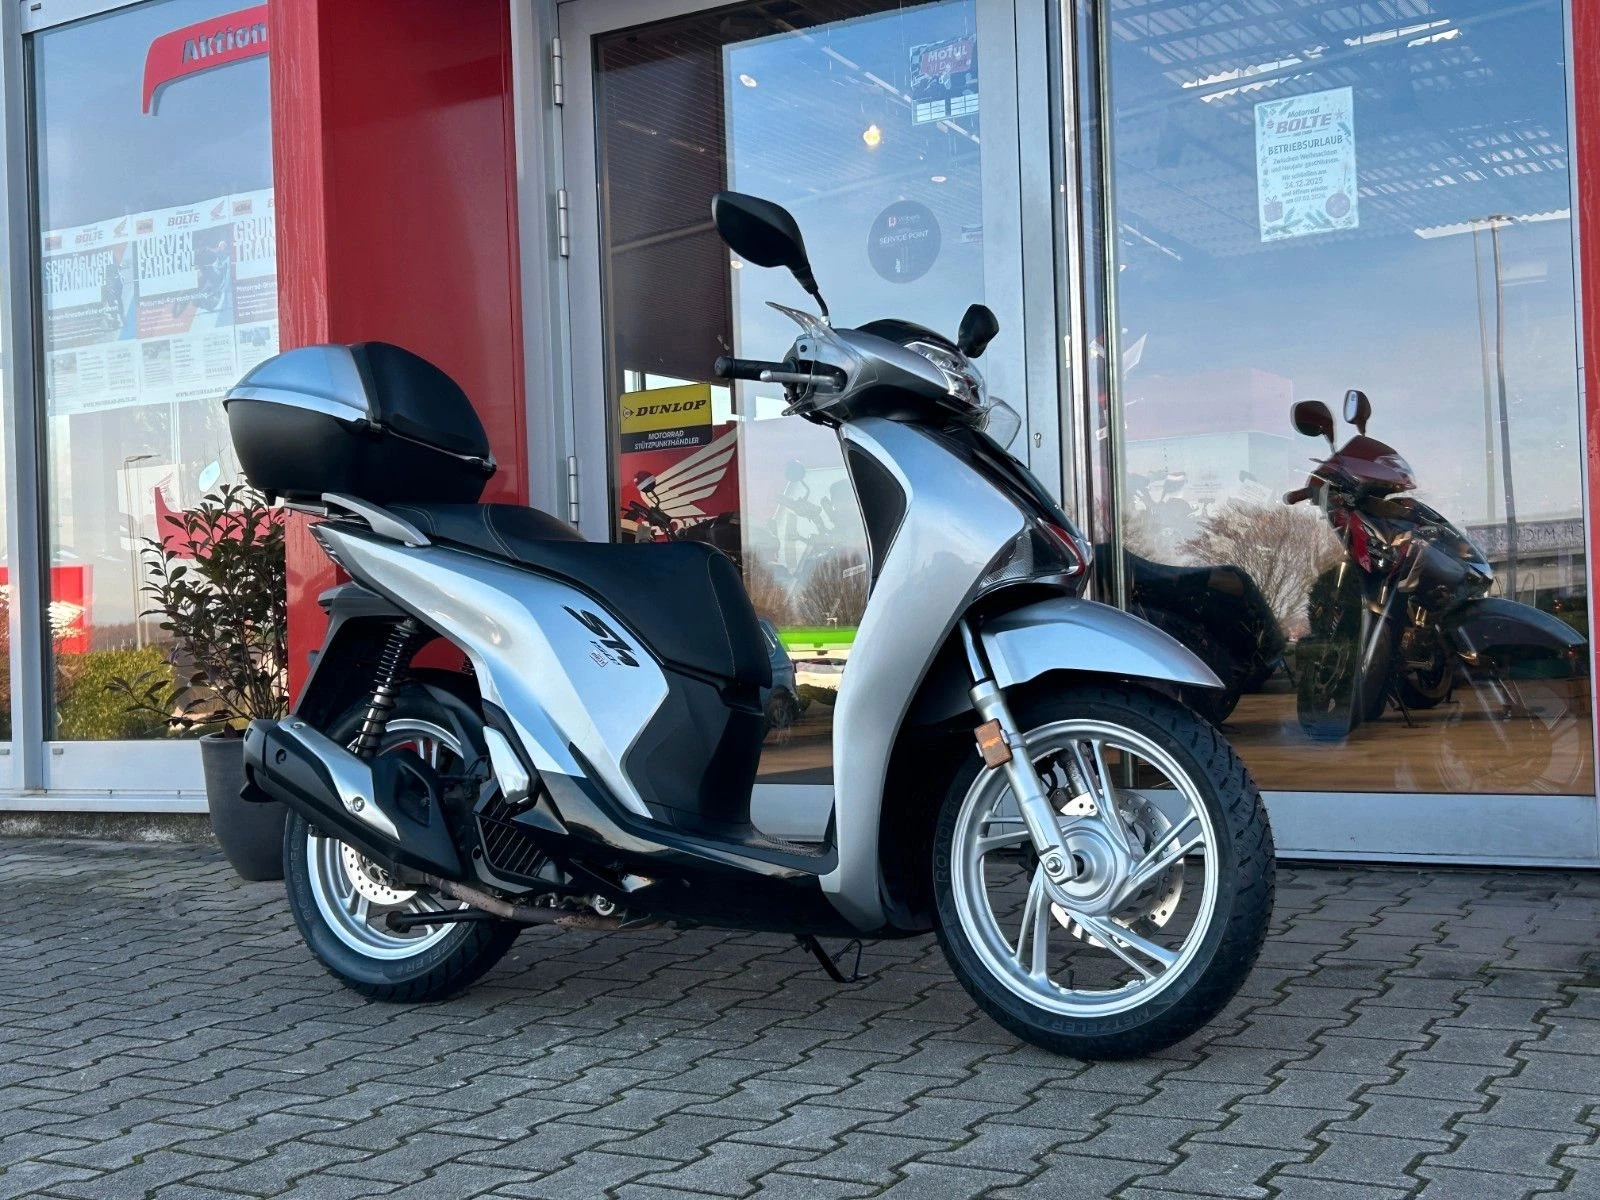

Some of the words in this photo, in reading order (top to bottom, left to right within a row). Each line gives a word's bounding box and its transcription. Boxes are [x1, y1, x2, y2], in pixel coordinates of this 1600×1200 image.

[182, 22, 267, 64] Aktion
[928, 45, 968, 62] MOTUL
[1275, 112, 1332, 134] BOLTE
[1268, 135, 1343, 155] BETRIEBSURLAUB
[168, 211, 200, 227] BOLTE
[137, 231, 193, 260] KURVEN
[45, 250, 114, 276] SCHRÄGLAGEN
[635, 399, 707, 417] DUNLOP
[634, 437, 700, 450] STÜTZPUNKTHÄNDLER
[648, 430, 685, 441] MOTORRAD
